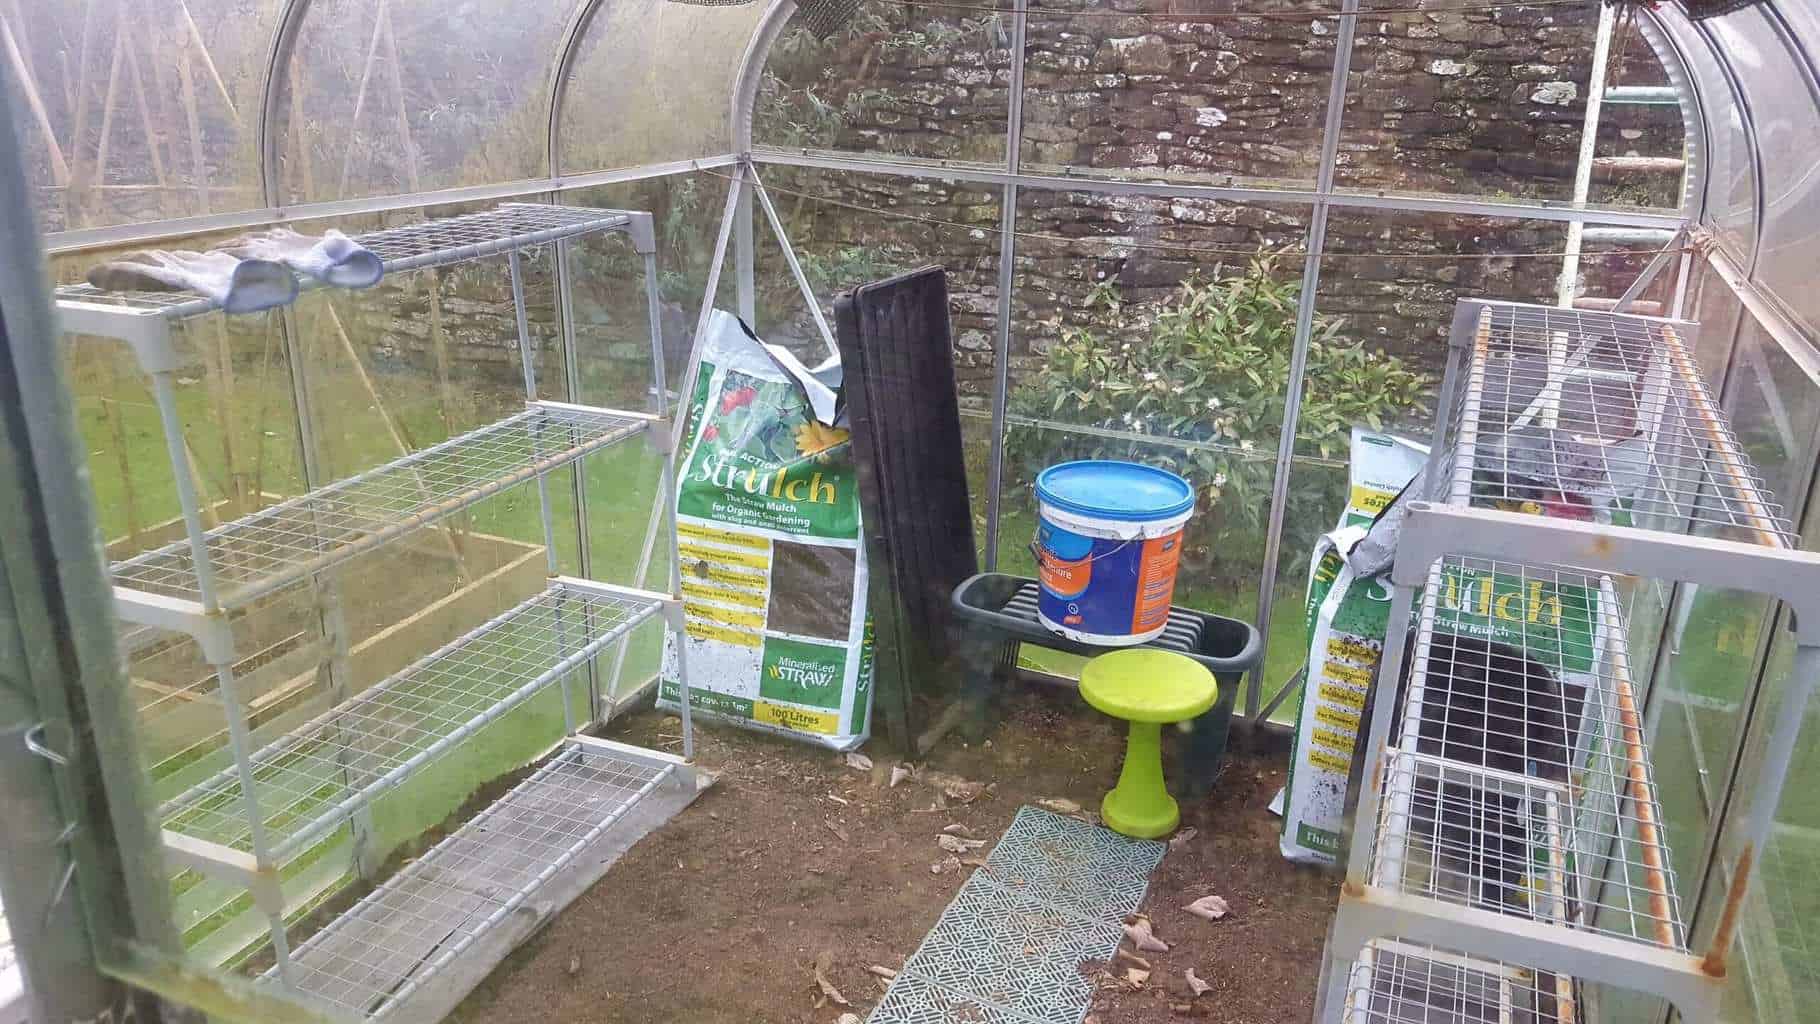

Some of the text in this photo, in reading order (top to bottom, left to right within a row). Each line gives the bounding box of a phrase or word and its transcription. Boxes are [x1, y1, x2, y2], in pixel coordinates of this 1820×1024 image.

[692, 454, 836, 504] Strulch
[712, 503, 811, 528] for Organic Gardening
[766, 501, 797, 514] Mulch
[1433, 615, 1468, 631] Straw
[1469, 621, 1510, 638] Mulch
[779, 655, 836, 673] Mineralised
[778, 666, 833, 690] STRAW
[664, 686, 681, 697] This
[771, 708, 820, 724] 100 Litres
